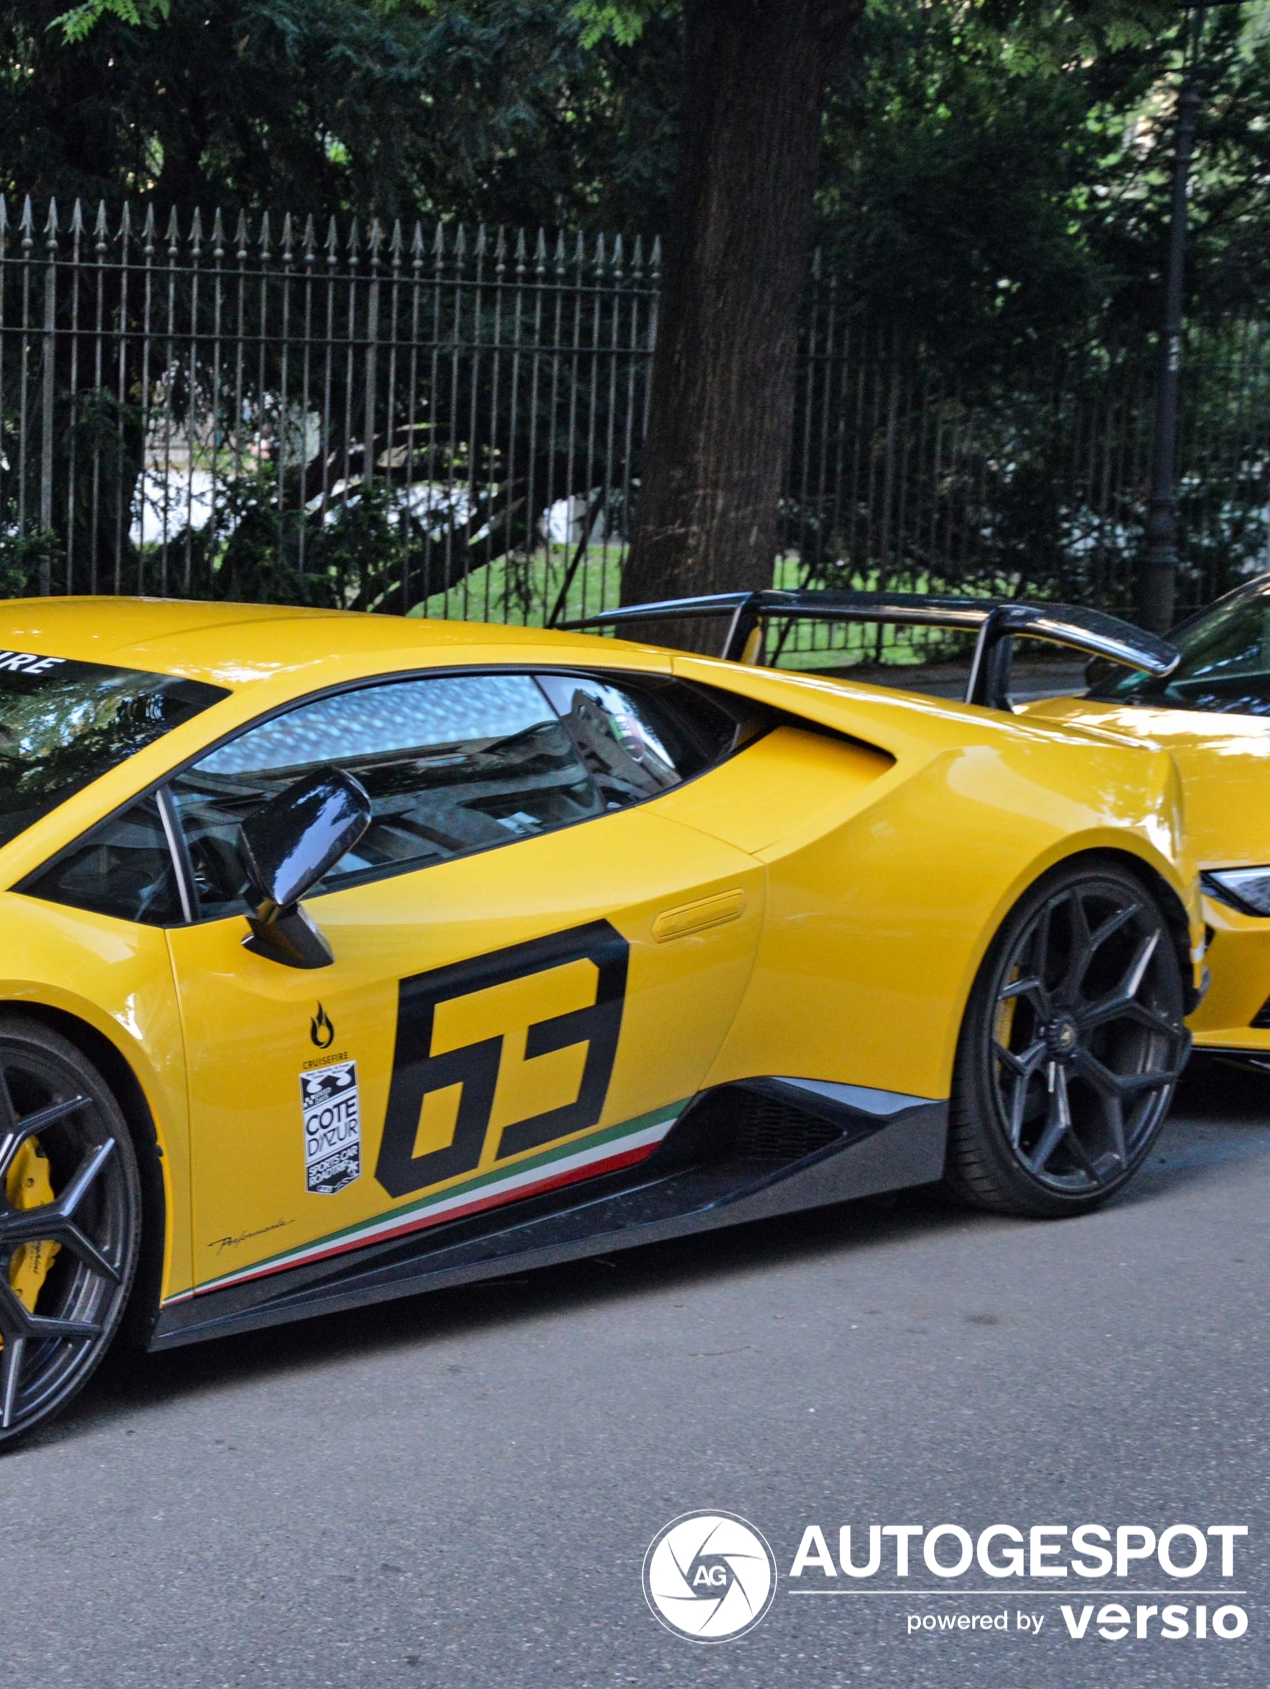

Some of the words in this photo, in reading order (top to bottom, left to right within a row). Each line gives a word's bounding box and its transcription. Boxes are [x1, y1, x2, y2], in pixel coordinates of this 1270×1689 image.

[302, 1051, 349, 1070] CRUISEFIRE
[374, 917, 630, 1199] 63
[306, 1094, 357, 1136] COTE
[308, 1154, 340, 1177] SPORTS
[340, 1145, 358, 1161] CAR
